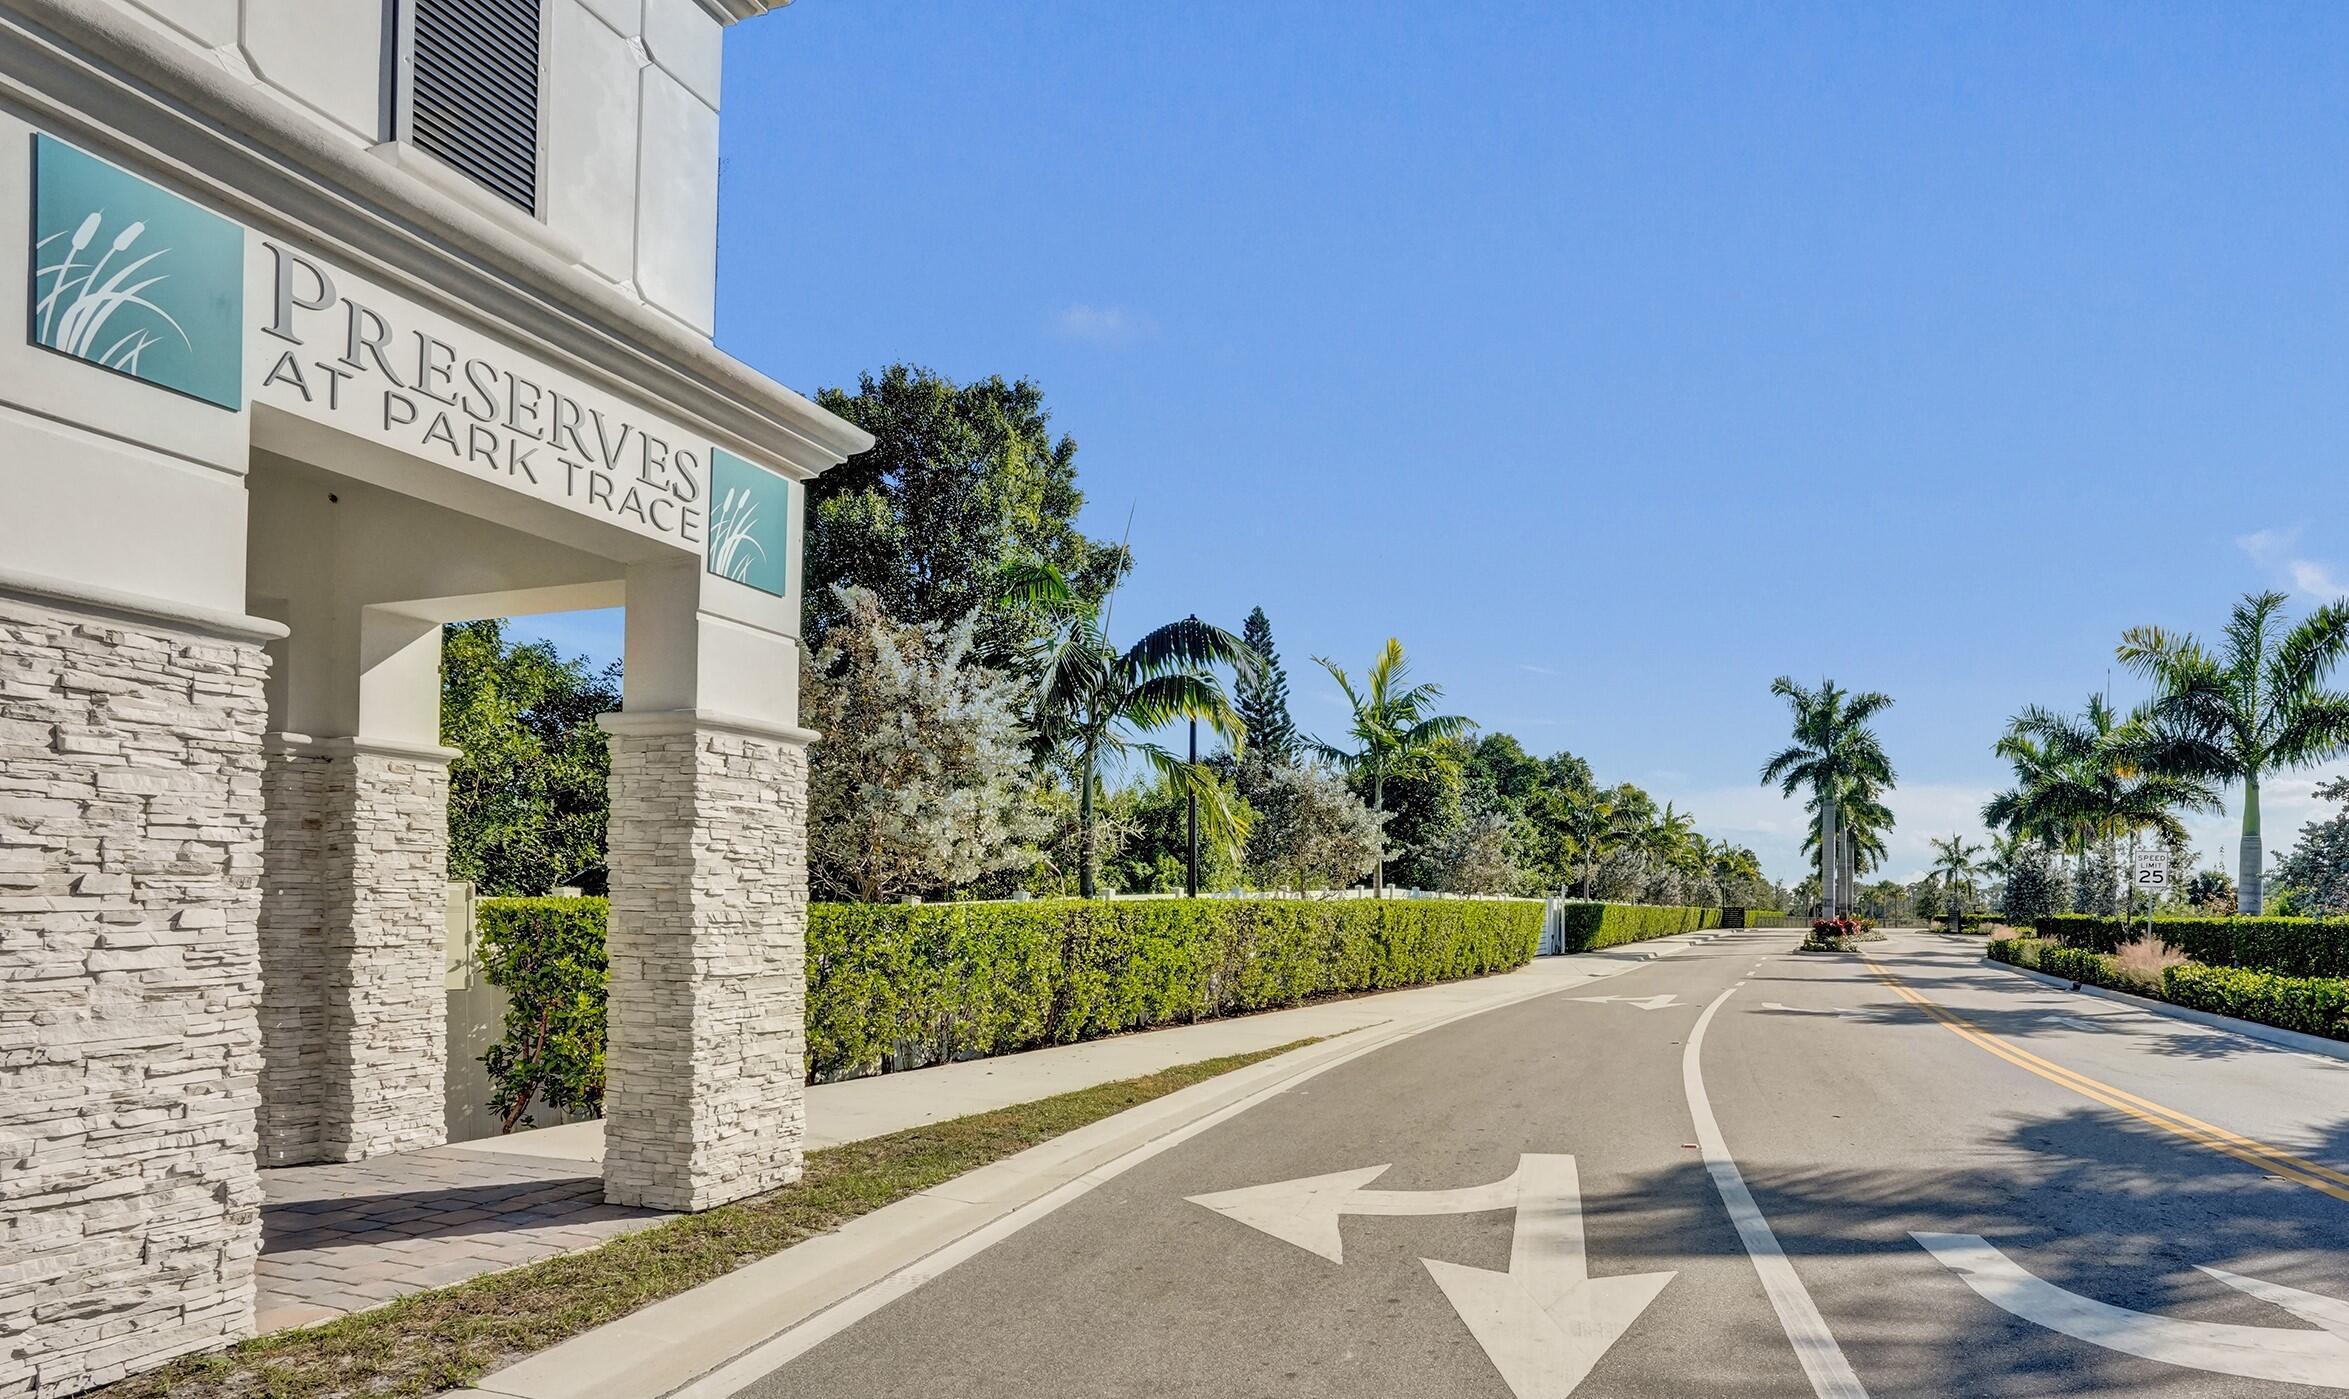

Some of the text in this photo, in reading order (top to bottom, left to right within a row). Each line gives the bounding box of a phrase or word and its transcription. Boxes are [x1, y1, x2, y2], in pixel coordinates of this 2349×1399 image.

[261, 241, 700, 502] PRESERVES
[263, 350, 701, 543] AT PARK TRACE
[2139, 870, 2163, 883] 25
